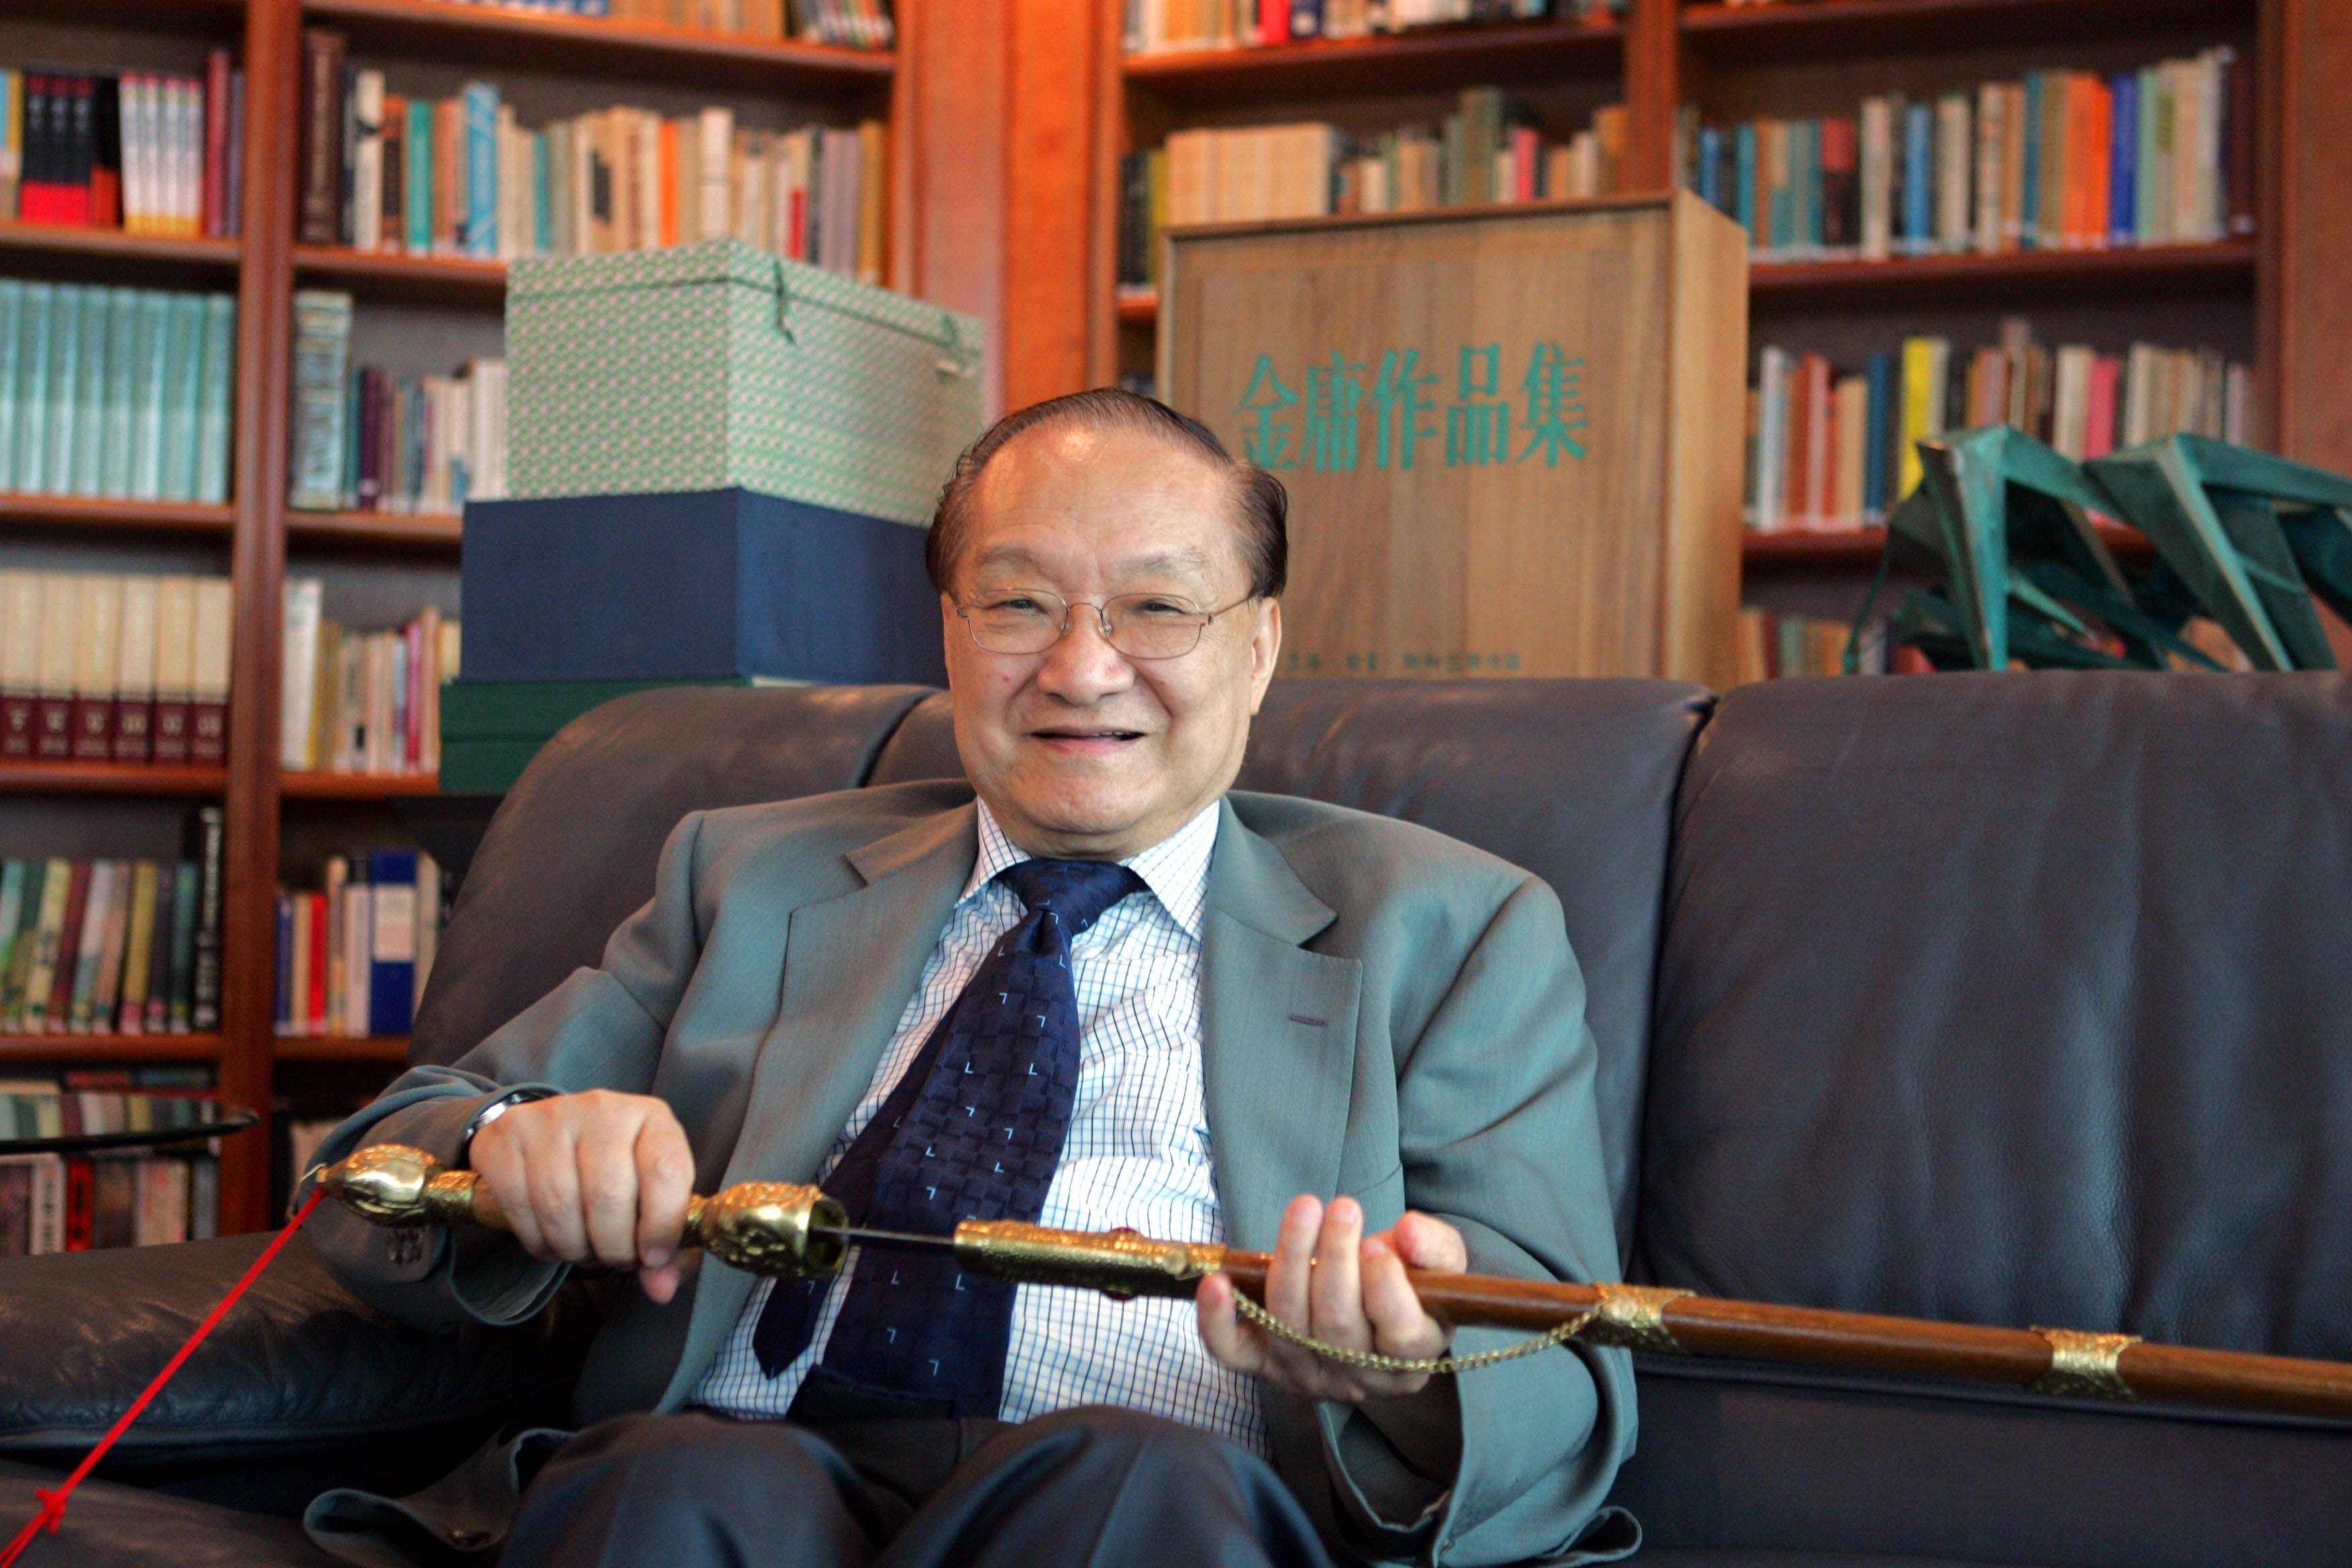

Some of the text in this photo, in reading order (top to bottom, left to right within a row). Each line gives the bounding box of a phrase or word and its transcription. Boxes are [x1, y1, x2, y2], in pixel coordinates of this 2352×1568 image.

[1232, 341, 1588, 473] 金庸作品集
